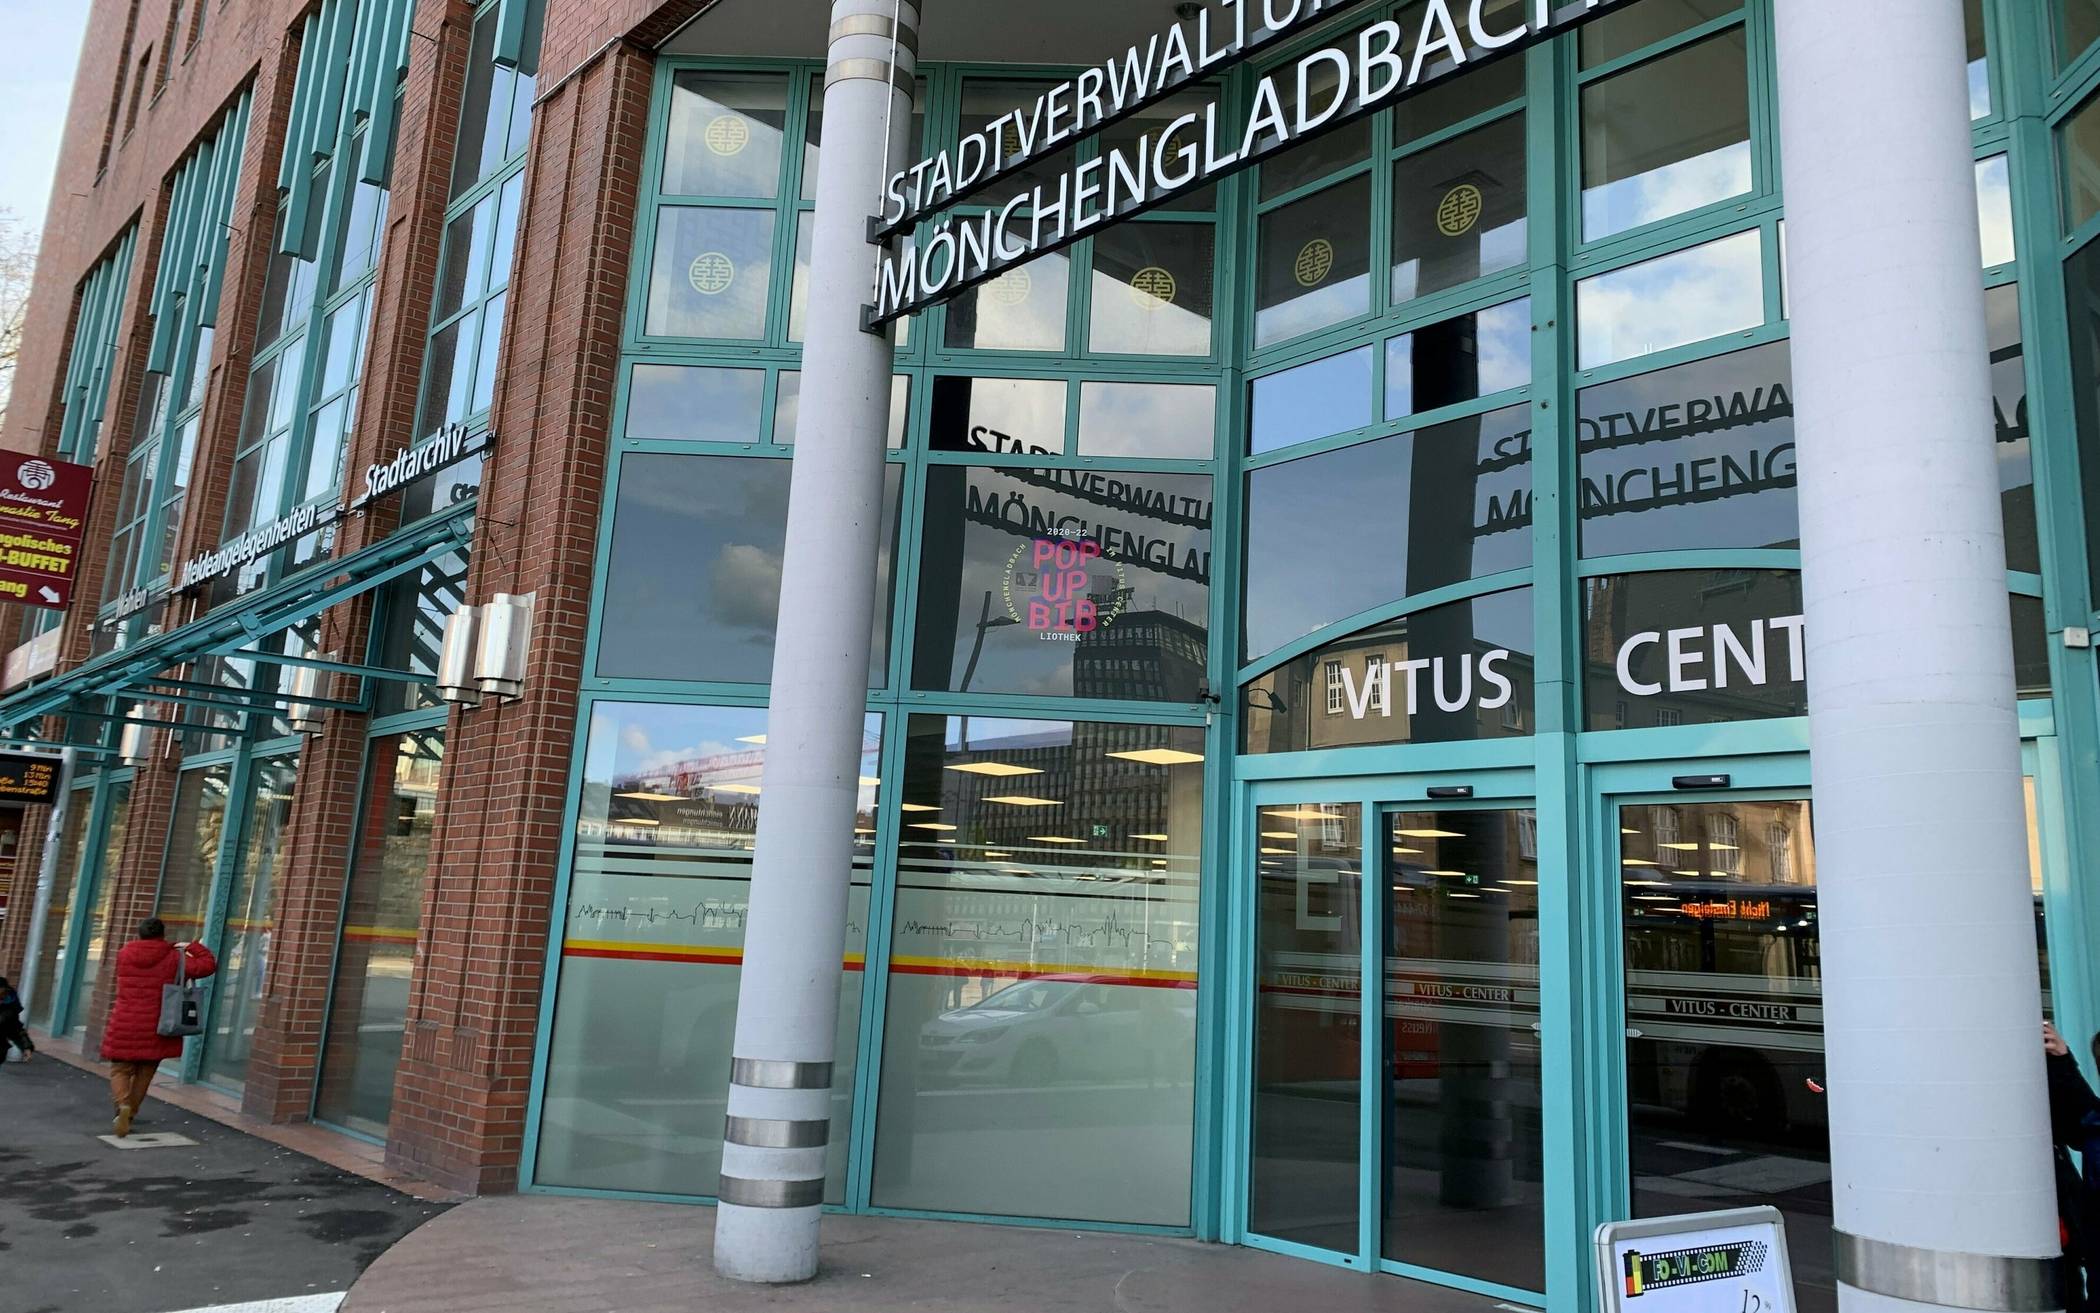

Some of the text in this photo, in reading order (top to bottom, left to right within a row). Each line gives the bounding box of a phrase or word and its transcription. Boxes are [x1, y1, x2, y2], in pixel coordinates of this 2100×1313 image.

[362, 424, 465, 499] Stadtarchiv
[45, 510, 80, 529] Tang
[181, 504, 317, 587] Meldeangelegenheiten
[1033, 540, 1101, 569] POP
[1042, 570, 1088, 602] UP
[1028, 600, 1098, 632] BIB
[1040, 632, 1081, 641] LIOTHEK
[1341, 649, 1512, 720] VITUS
[1282, 974, 1311, 988] VITUS
[1319, 977, 1360, 991] CENTER
[1419, 983, 1453, 998] VITUS
[1463, 986, 1510, 1001] CENTER
[1672, 1000, 1715, 1015] VITUS
[1729, 1002, 1790, 1020] CENTER
